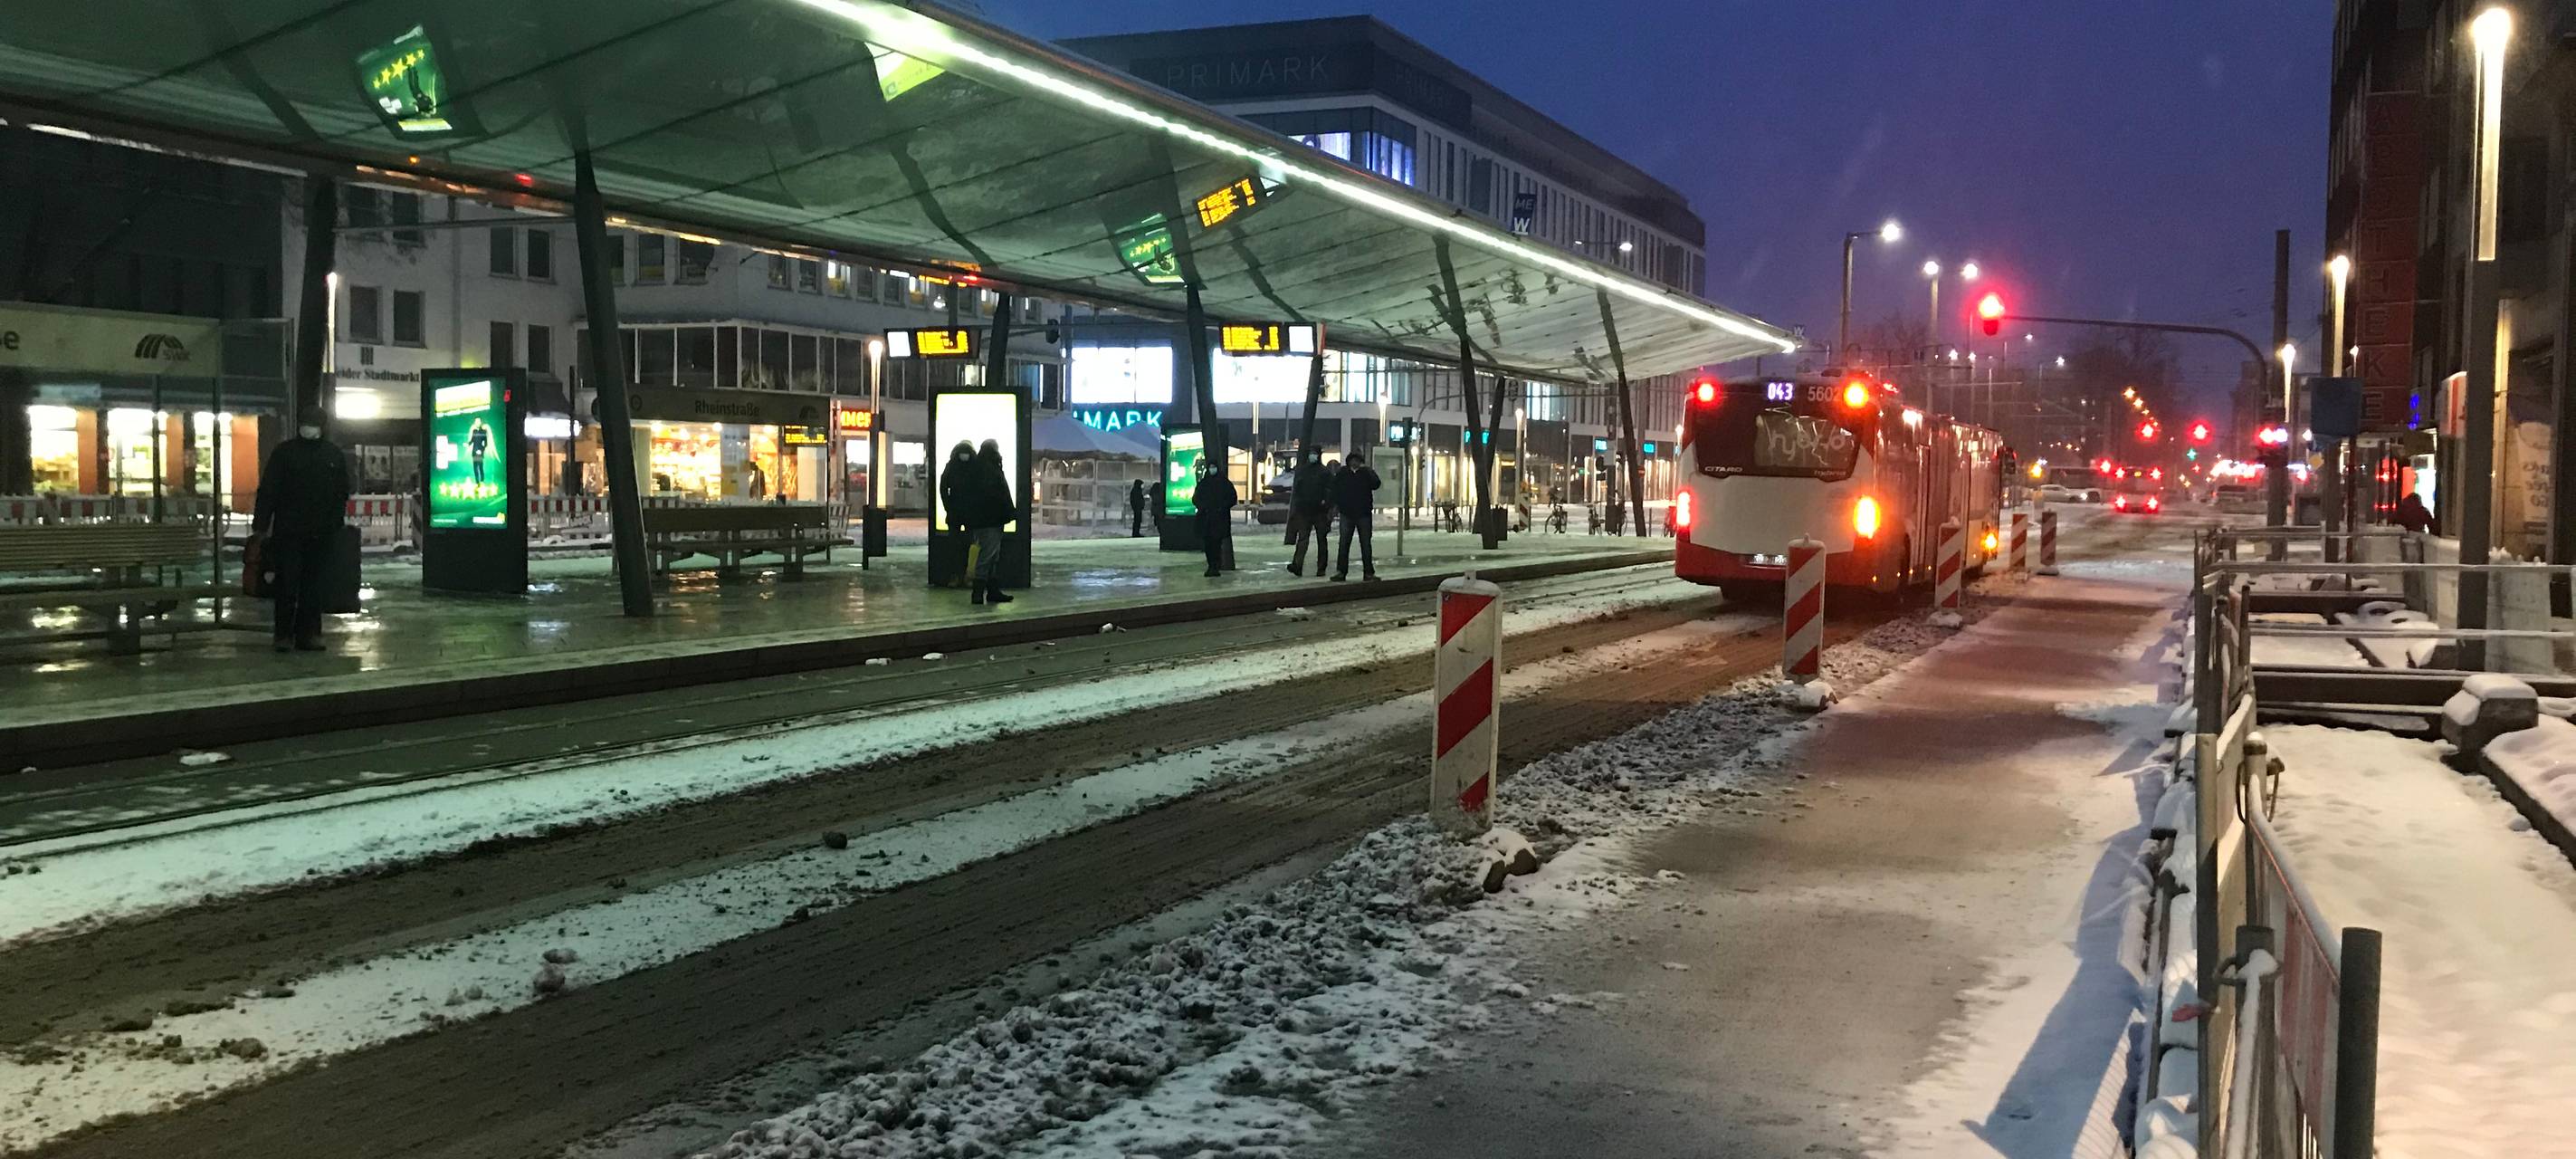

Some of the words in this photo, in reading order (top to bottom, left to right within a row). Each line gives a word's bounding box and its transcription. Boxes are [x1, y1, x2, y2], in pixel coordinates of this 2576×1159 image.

[1167, 55, 1329, 88] PRIMARK
[0, 330, 19, 350] e
[1768, 382, 1793, 400] 043
[1808, 386, 1841, 401] 5602
[694, 399, 760, 417] Rheinstraße
